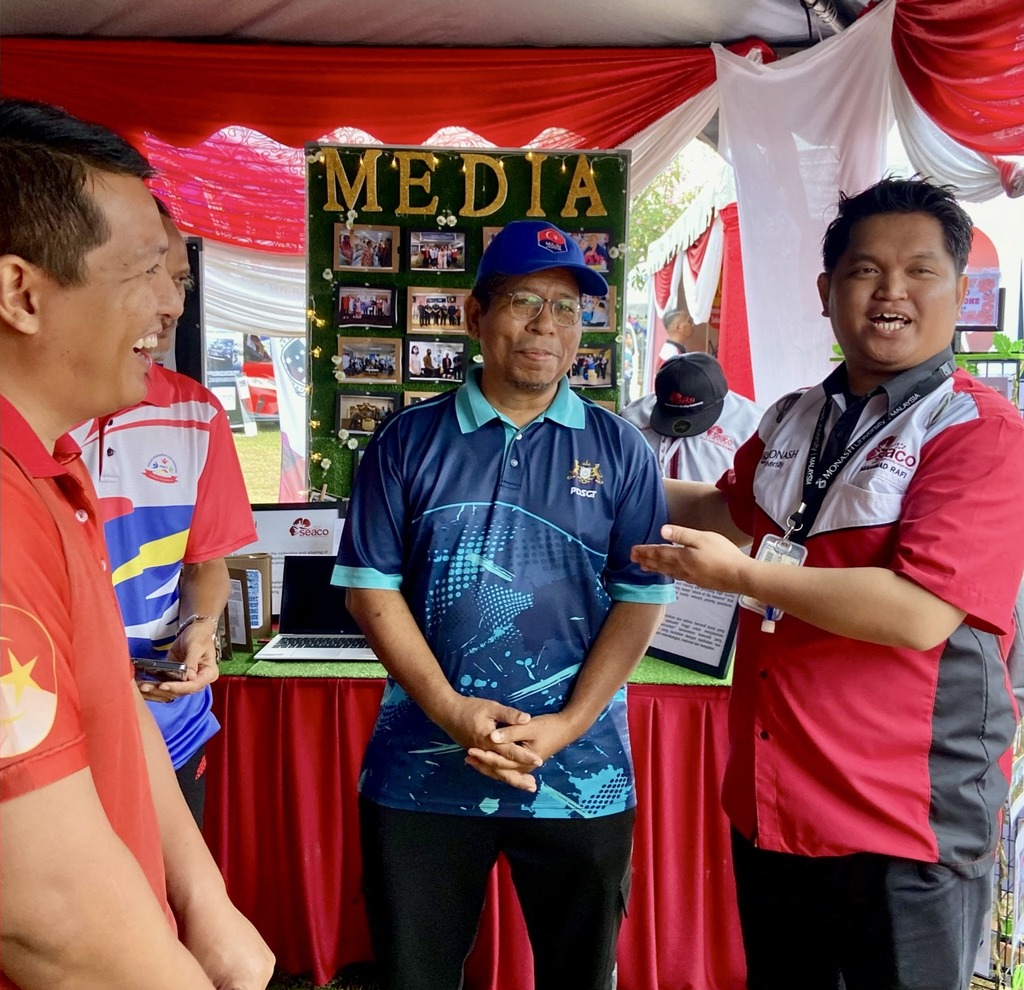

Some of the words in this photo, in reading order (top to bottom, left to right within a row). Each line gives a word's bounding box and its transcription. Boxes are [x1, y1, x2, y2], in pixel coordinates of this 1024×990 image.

[320, 147, 607, 218] MEDIA
[824, 445, 854, 480] MONASH
[853, 418, 886, 447] University
[890, 393, 921, 417] MALAYSIA
[804, 455, 817, 486] MALAYSIA
[889, 465, 908, 480] RAFI
[299, 528, 329, 537] seaco
